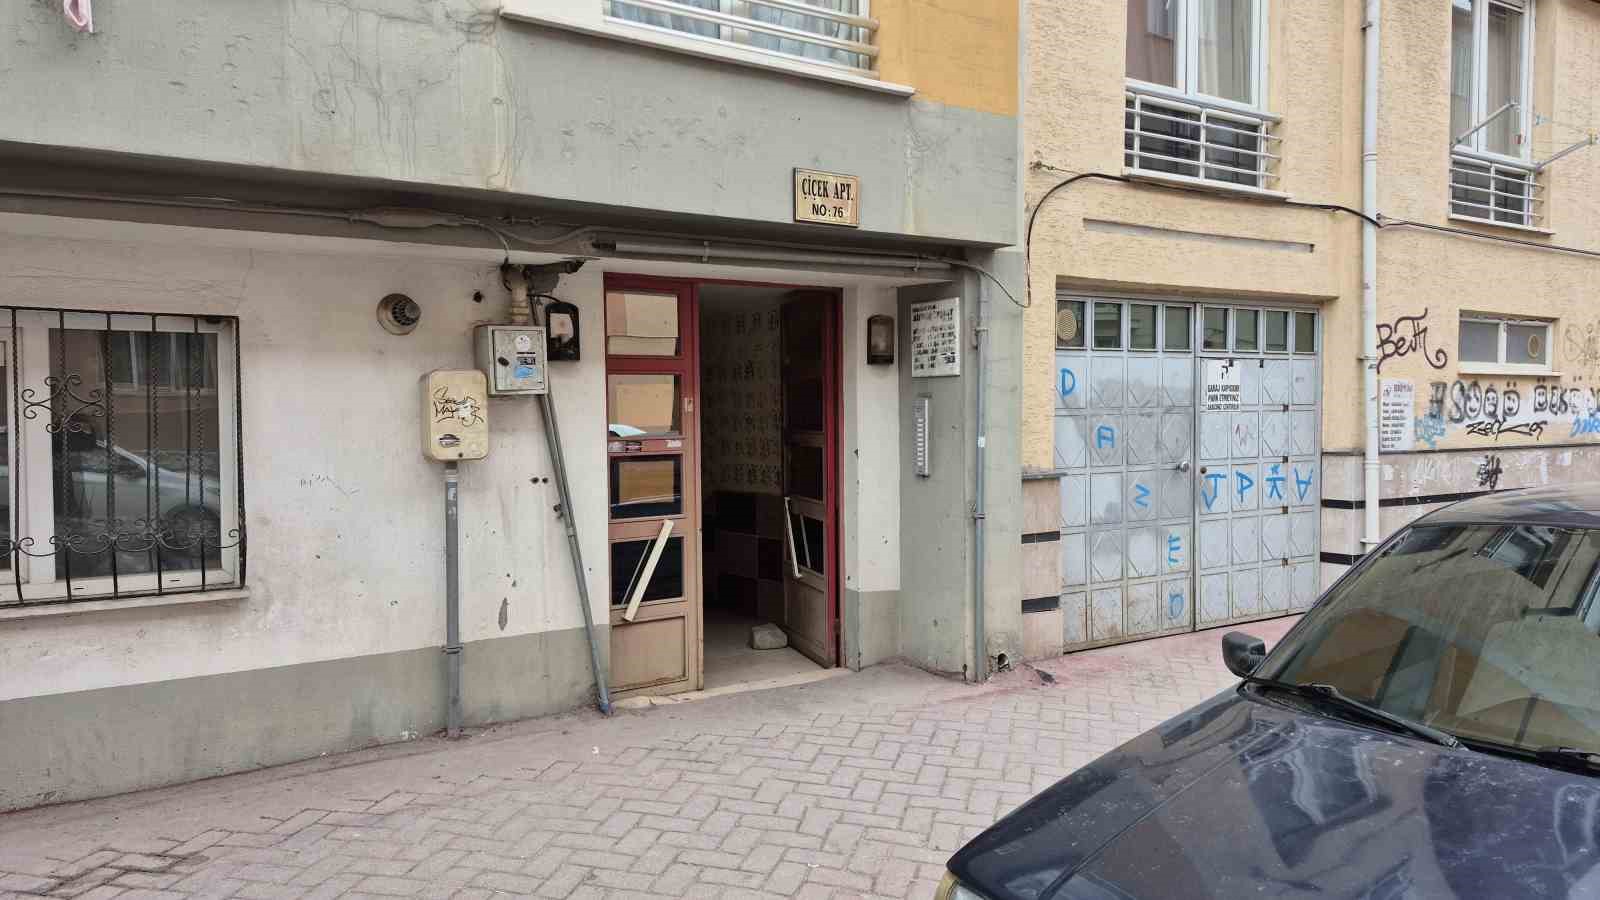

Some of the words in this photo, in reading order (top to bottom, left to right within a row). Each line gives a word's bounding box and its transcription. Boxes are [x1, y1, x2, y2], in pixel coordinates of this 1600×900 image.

[802, 175, 829, 201] ÇİÇEK
[833, 182, 854, 201] APT.
[1207, 384, 1221, 392] GARAJ
